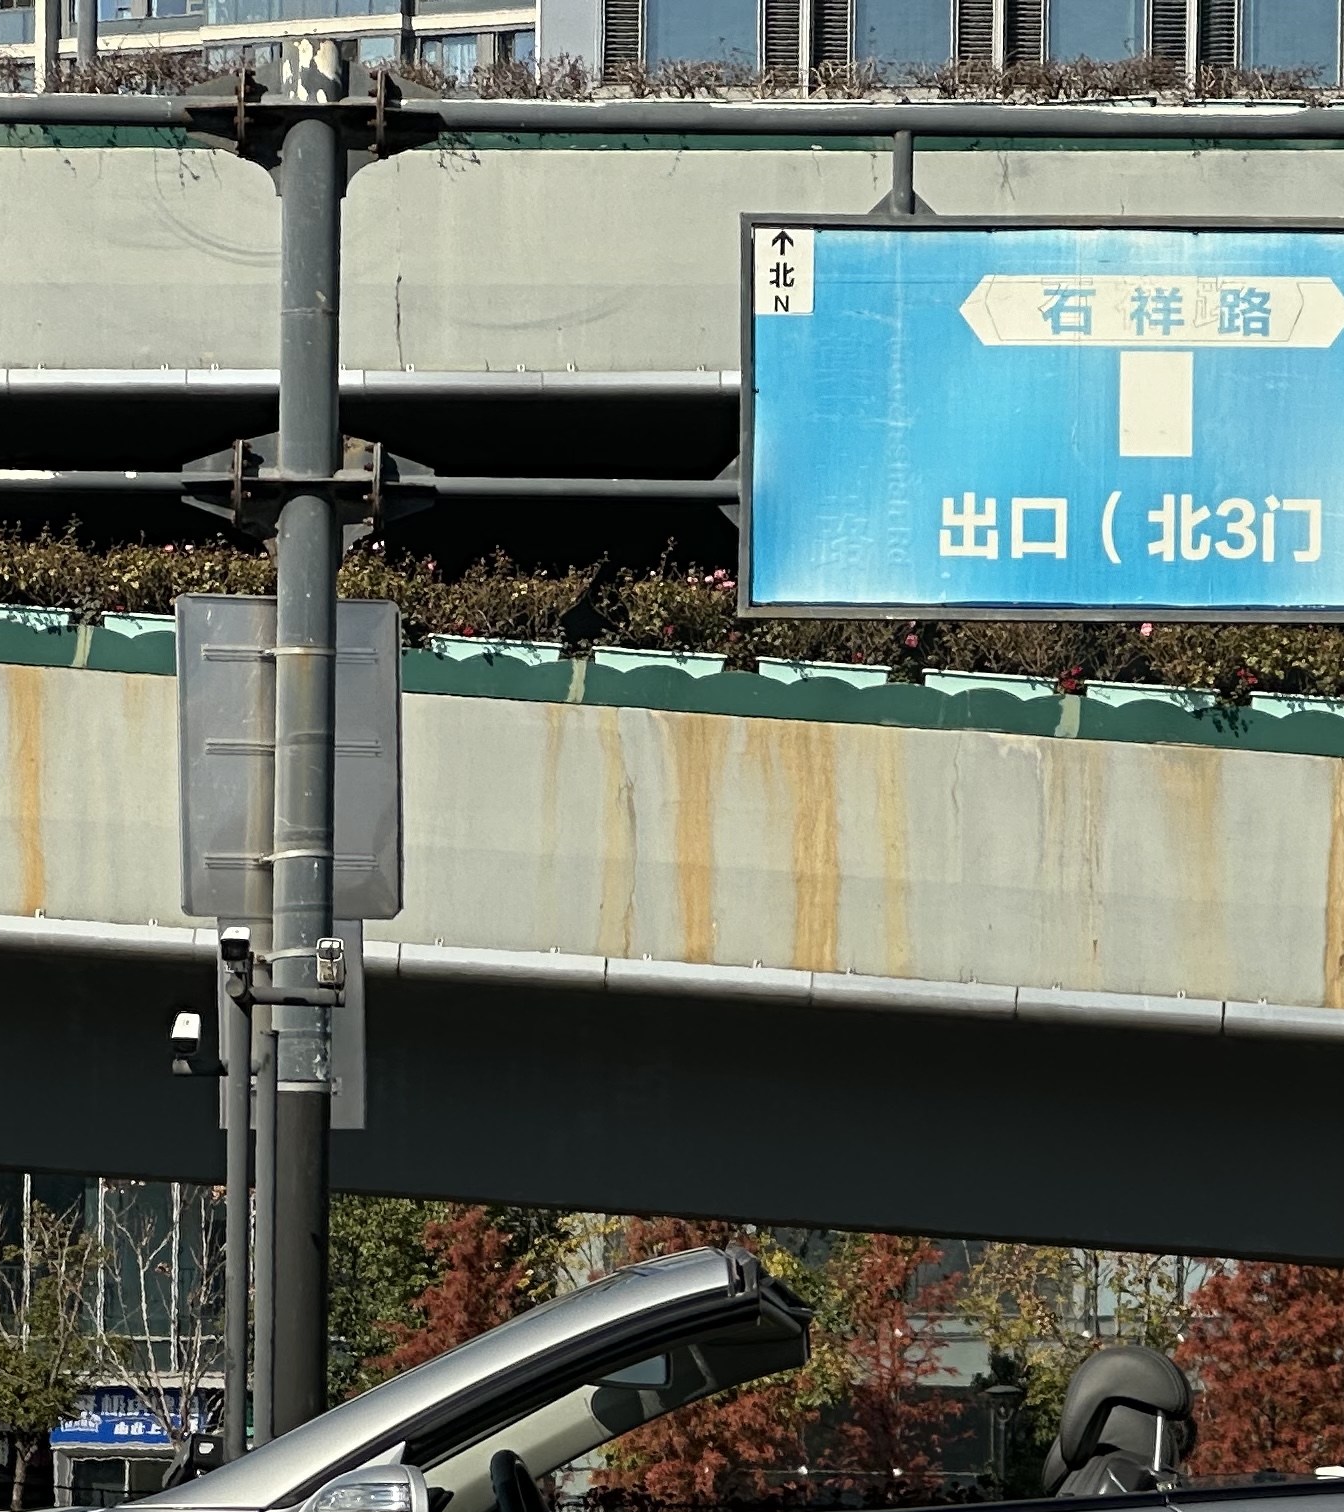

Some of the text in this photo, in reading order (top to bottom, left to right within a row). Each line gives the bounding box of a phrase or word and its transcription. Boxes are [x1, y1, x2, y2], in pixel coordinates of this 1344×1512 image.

[768, 261, 795, 288] 北
[773, 295, 790, 312] N
[1039, 287, 1272, 337] 石祥路
